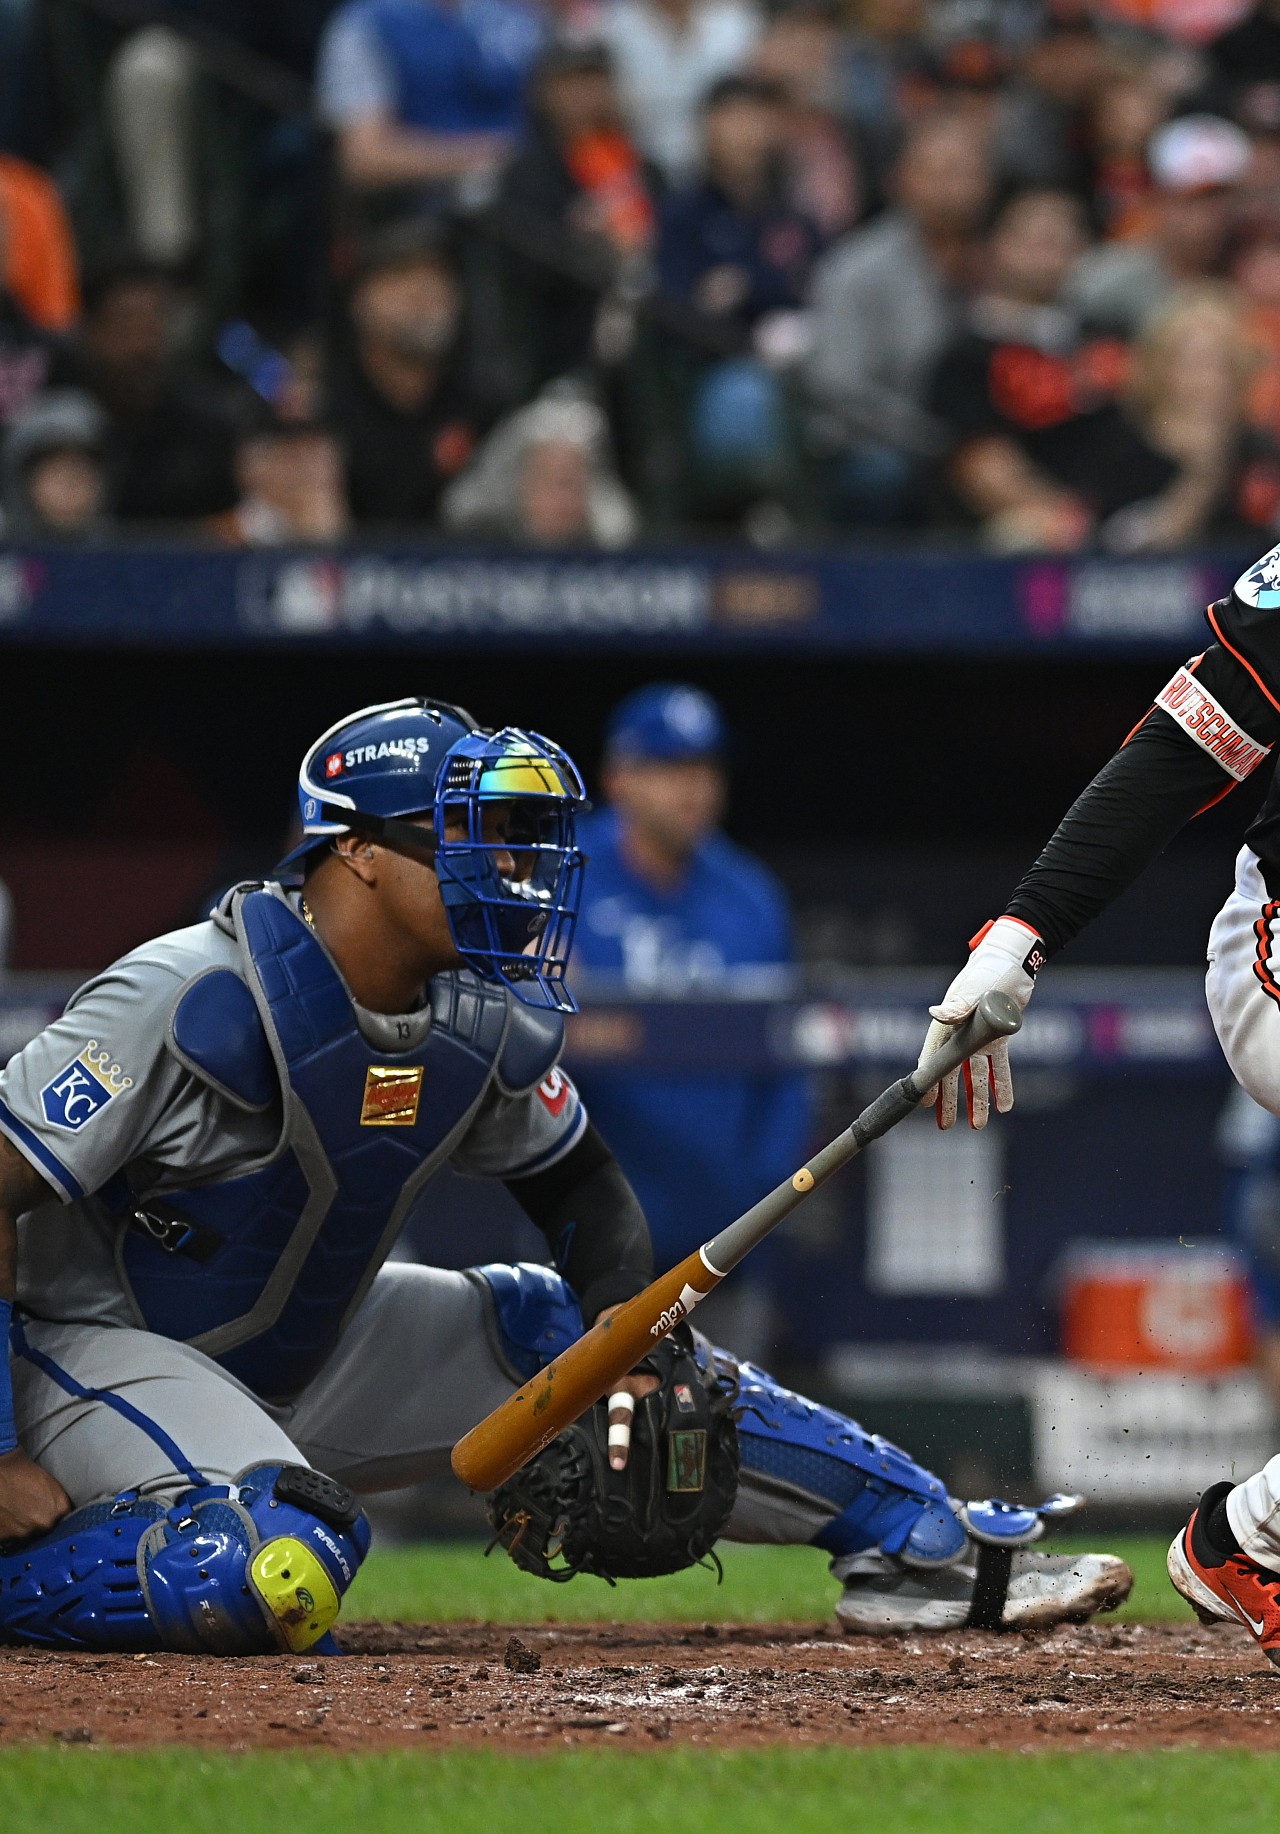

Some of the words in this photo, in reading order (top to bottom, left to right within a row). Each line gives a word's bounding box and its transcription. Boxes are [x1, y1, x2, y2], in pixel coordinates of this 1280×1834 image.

[345, 737, 430, 768] STRAUSS
[396, 1021, 410, 1040] 13
[52, 1067, 97, 1125] KC
[313, 1526, 351, 1581] RAWLINGS
